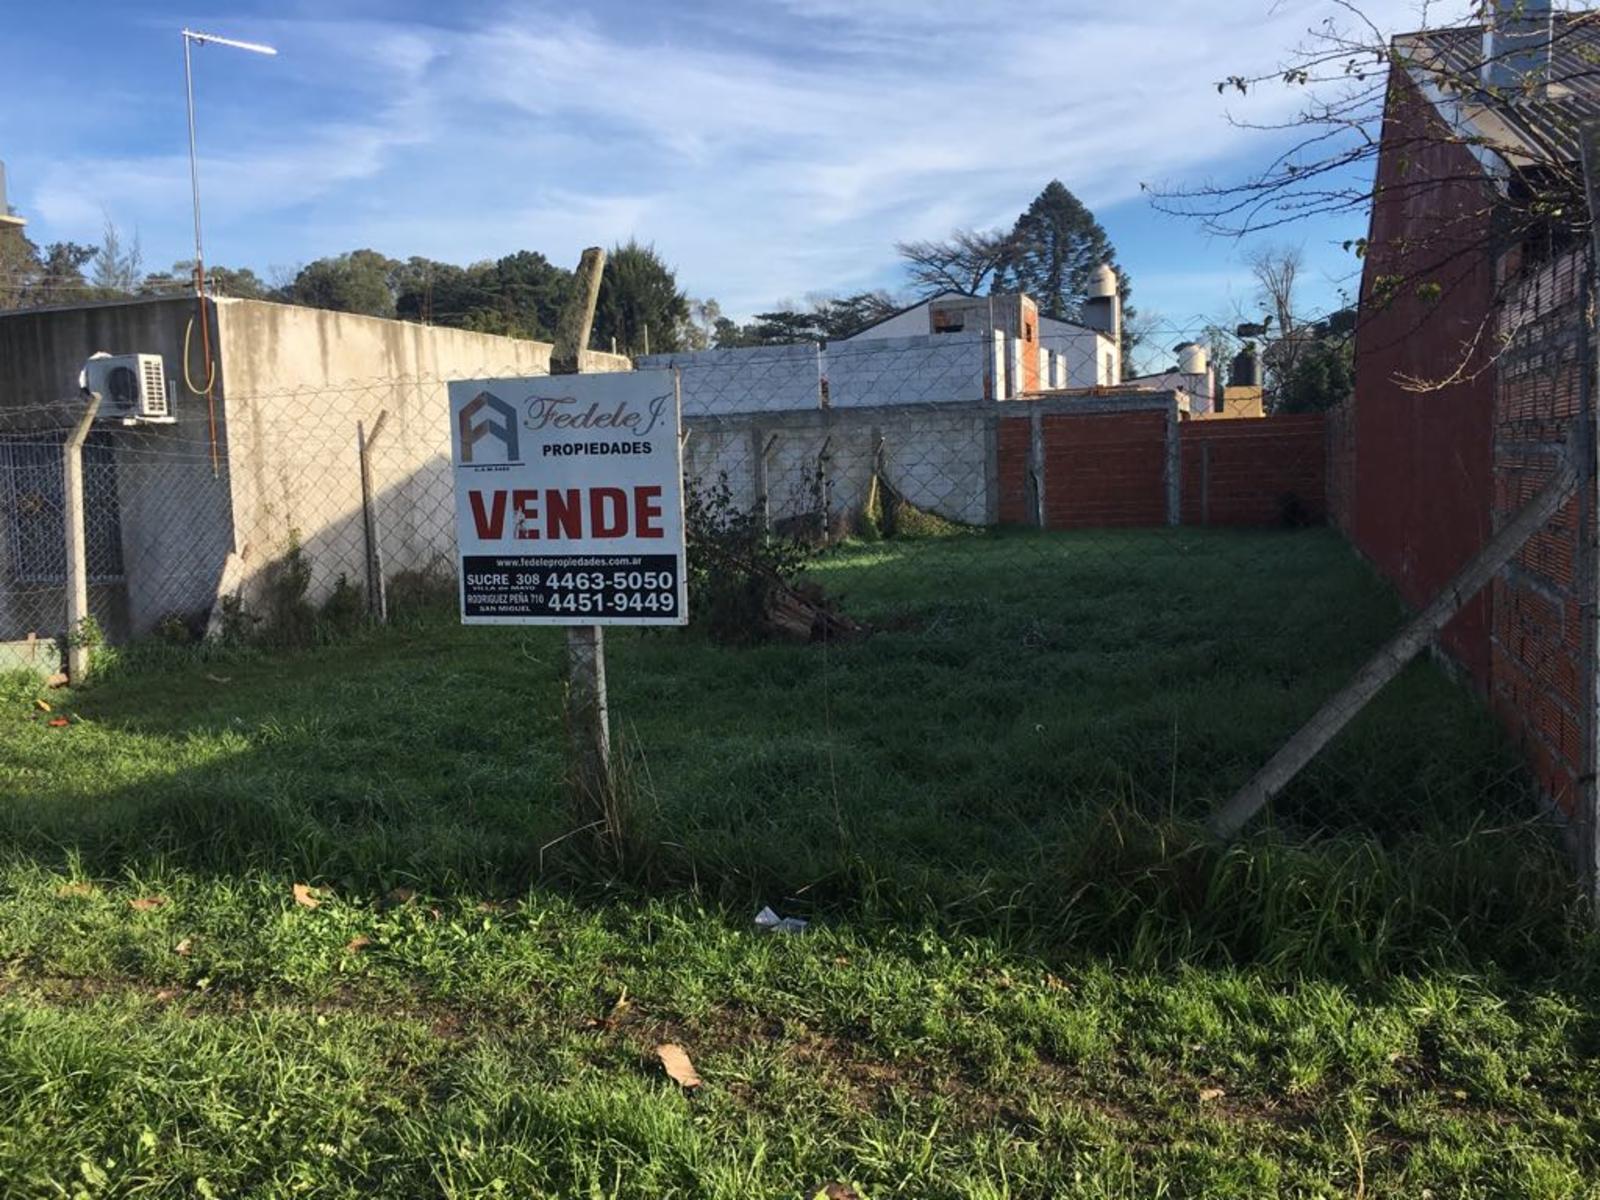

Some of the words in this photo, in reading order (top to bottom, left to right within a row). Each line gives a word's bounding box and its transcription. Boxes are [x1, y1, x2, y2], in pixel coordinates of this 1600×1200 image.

[524, 395, 641, 430] Fedele
[542, 441, 652, 457] PROPIEDADES
[468, 485, 664, 540] VENDE
[496, 557, 642, 569] www.fedelepropiedades.com.ar
[466, 573, 509, 586] SUCRE
[516, 573, 540, 585] 308
[546, 572, 673, 590] 4463-5050
[509, 591, 529, 604] PEÑA
[530, 593, 545, 604] 710
[548, 592, 674, 612] 4451-9449
